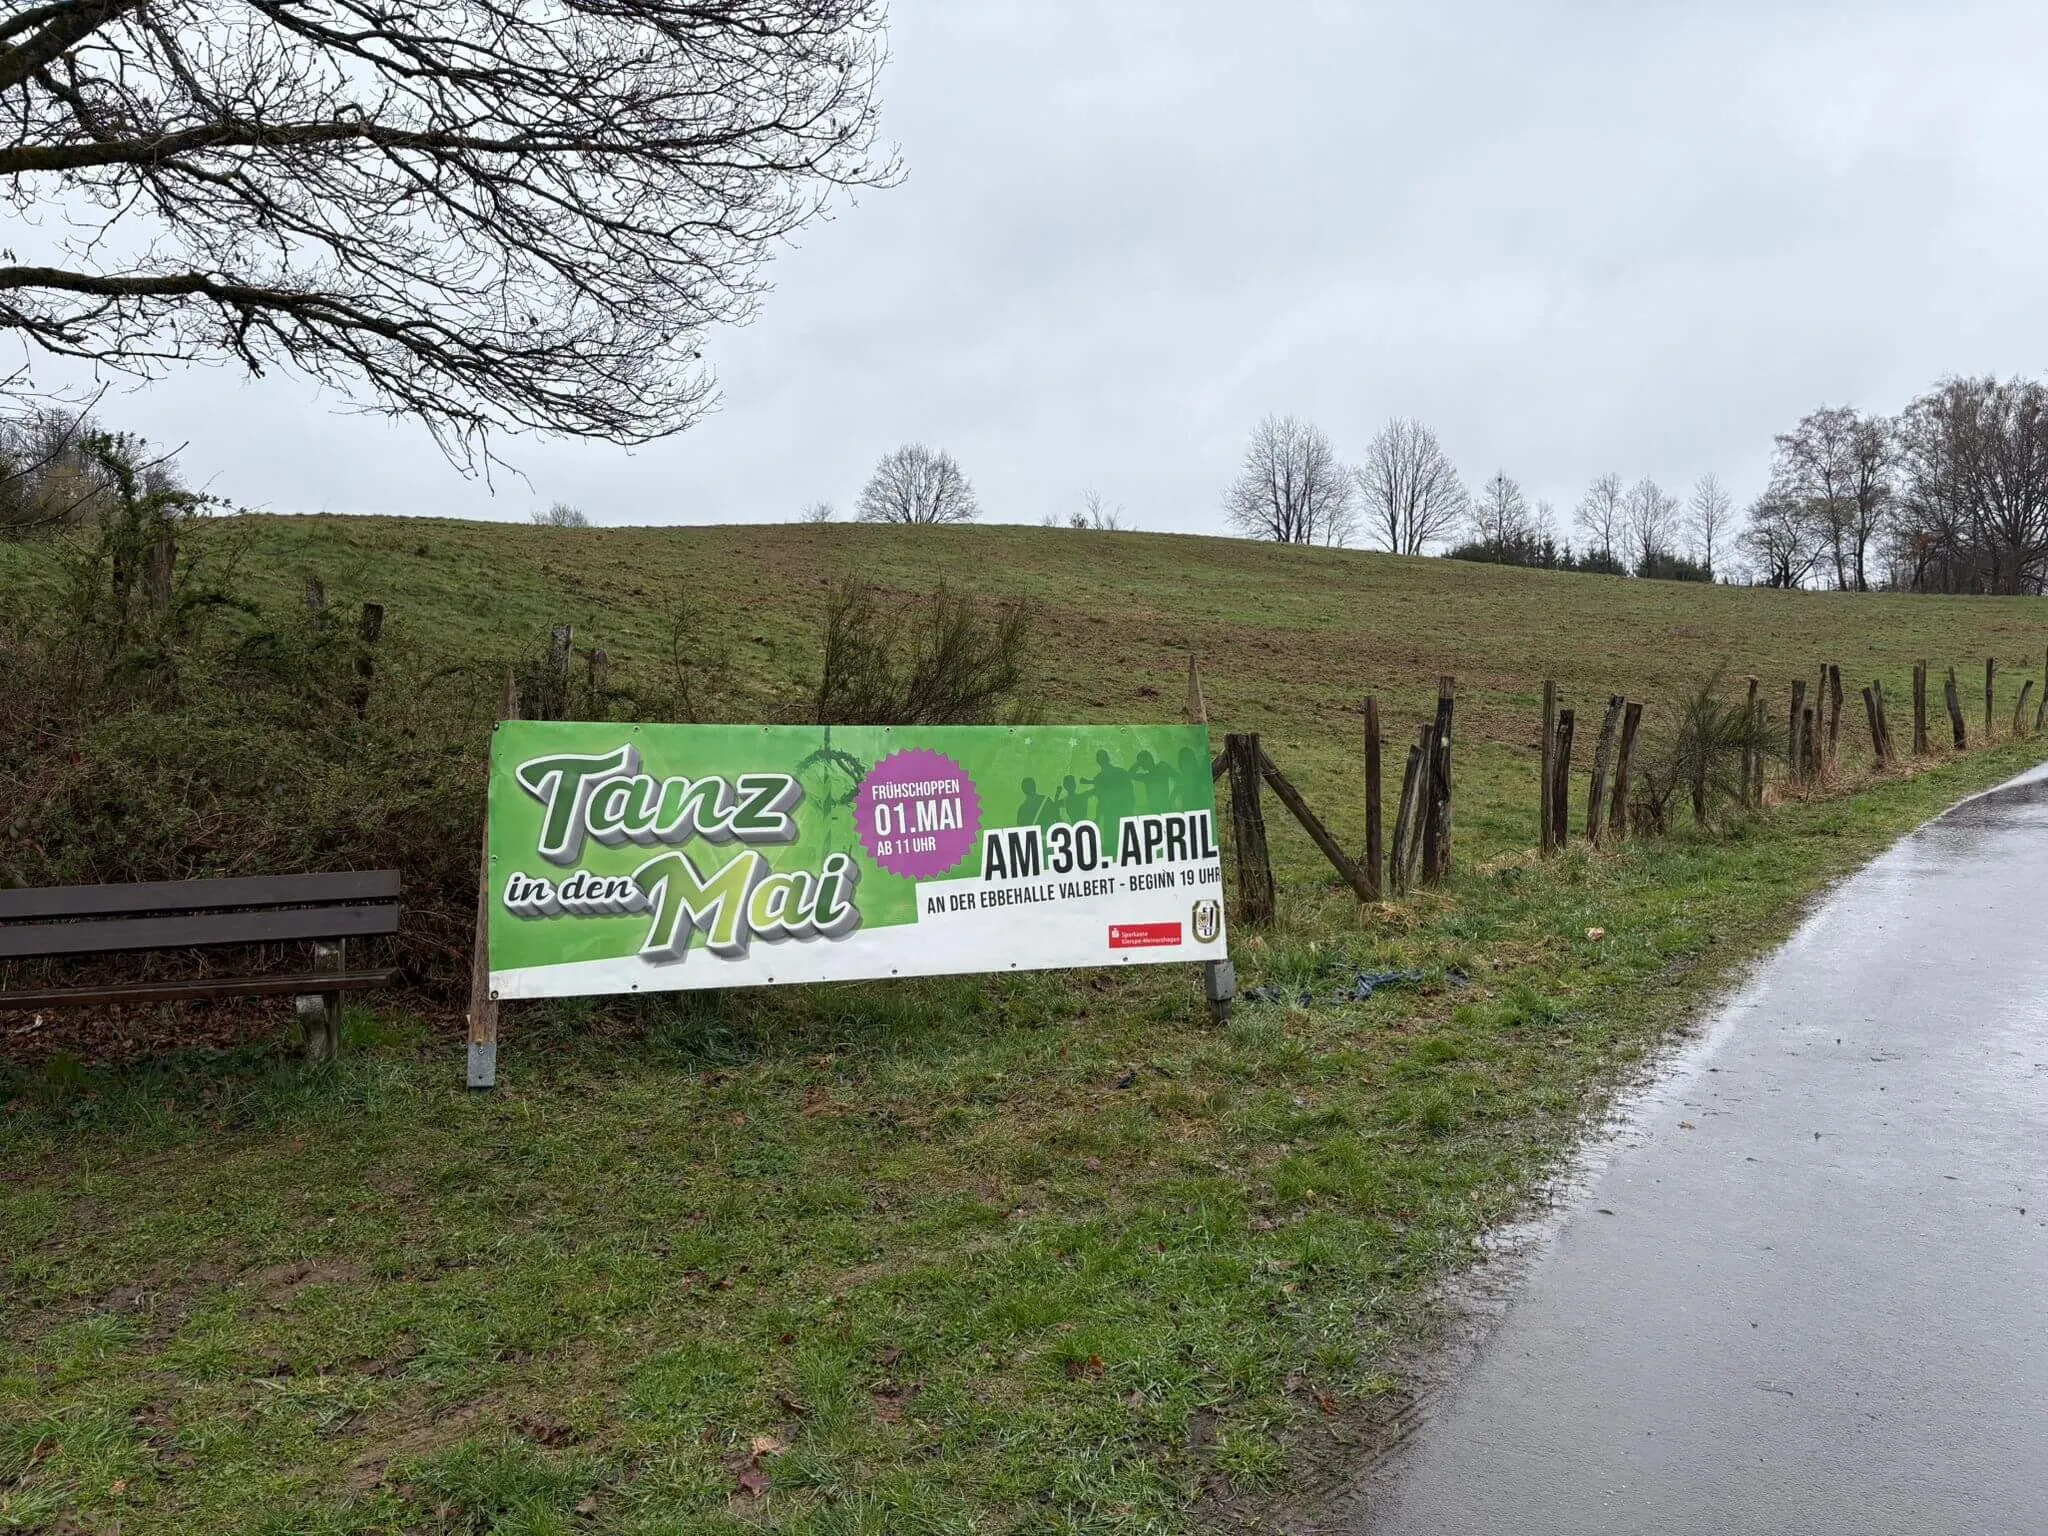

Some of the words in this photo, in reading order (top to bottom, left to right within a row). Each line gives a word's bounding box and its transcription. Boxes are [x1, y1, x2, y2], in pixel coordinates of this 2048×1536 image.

[515, 743, 801, 862] Tanz
[871, 779, 960, 800] FRÜHSCHOPPEN
[874, 798, 963, 836] 01.MAI
[877, 840, 893, 857] AB
[895, 839, 910, 855] 11
[913, 837, 937, 853] UHR
[985, 831, 1040, 881] AM
[1052, 825, 1109, 874] 30.
[1121, 814, 1218, 867] APRIL
[506, 873, 553, 903] in
[561, 872, 634, 901] den
[634, 851, 858, 958] Mai
[927, 895, 946, 915] AN
[950, 891, 976, 912] DER
[980, 884, 1056, 908] EBBEHALLE
[1059, 878, 1115, 899] VALBERT
[1129, 872, 1175, 891] BEGINN
[1180, 869, 1195, 886] 19
[1199, 866, 1220, 884] UHR
